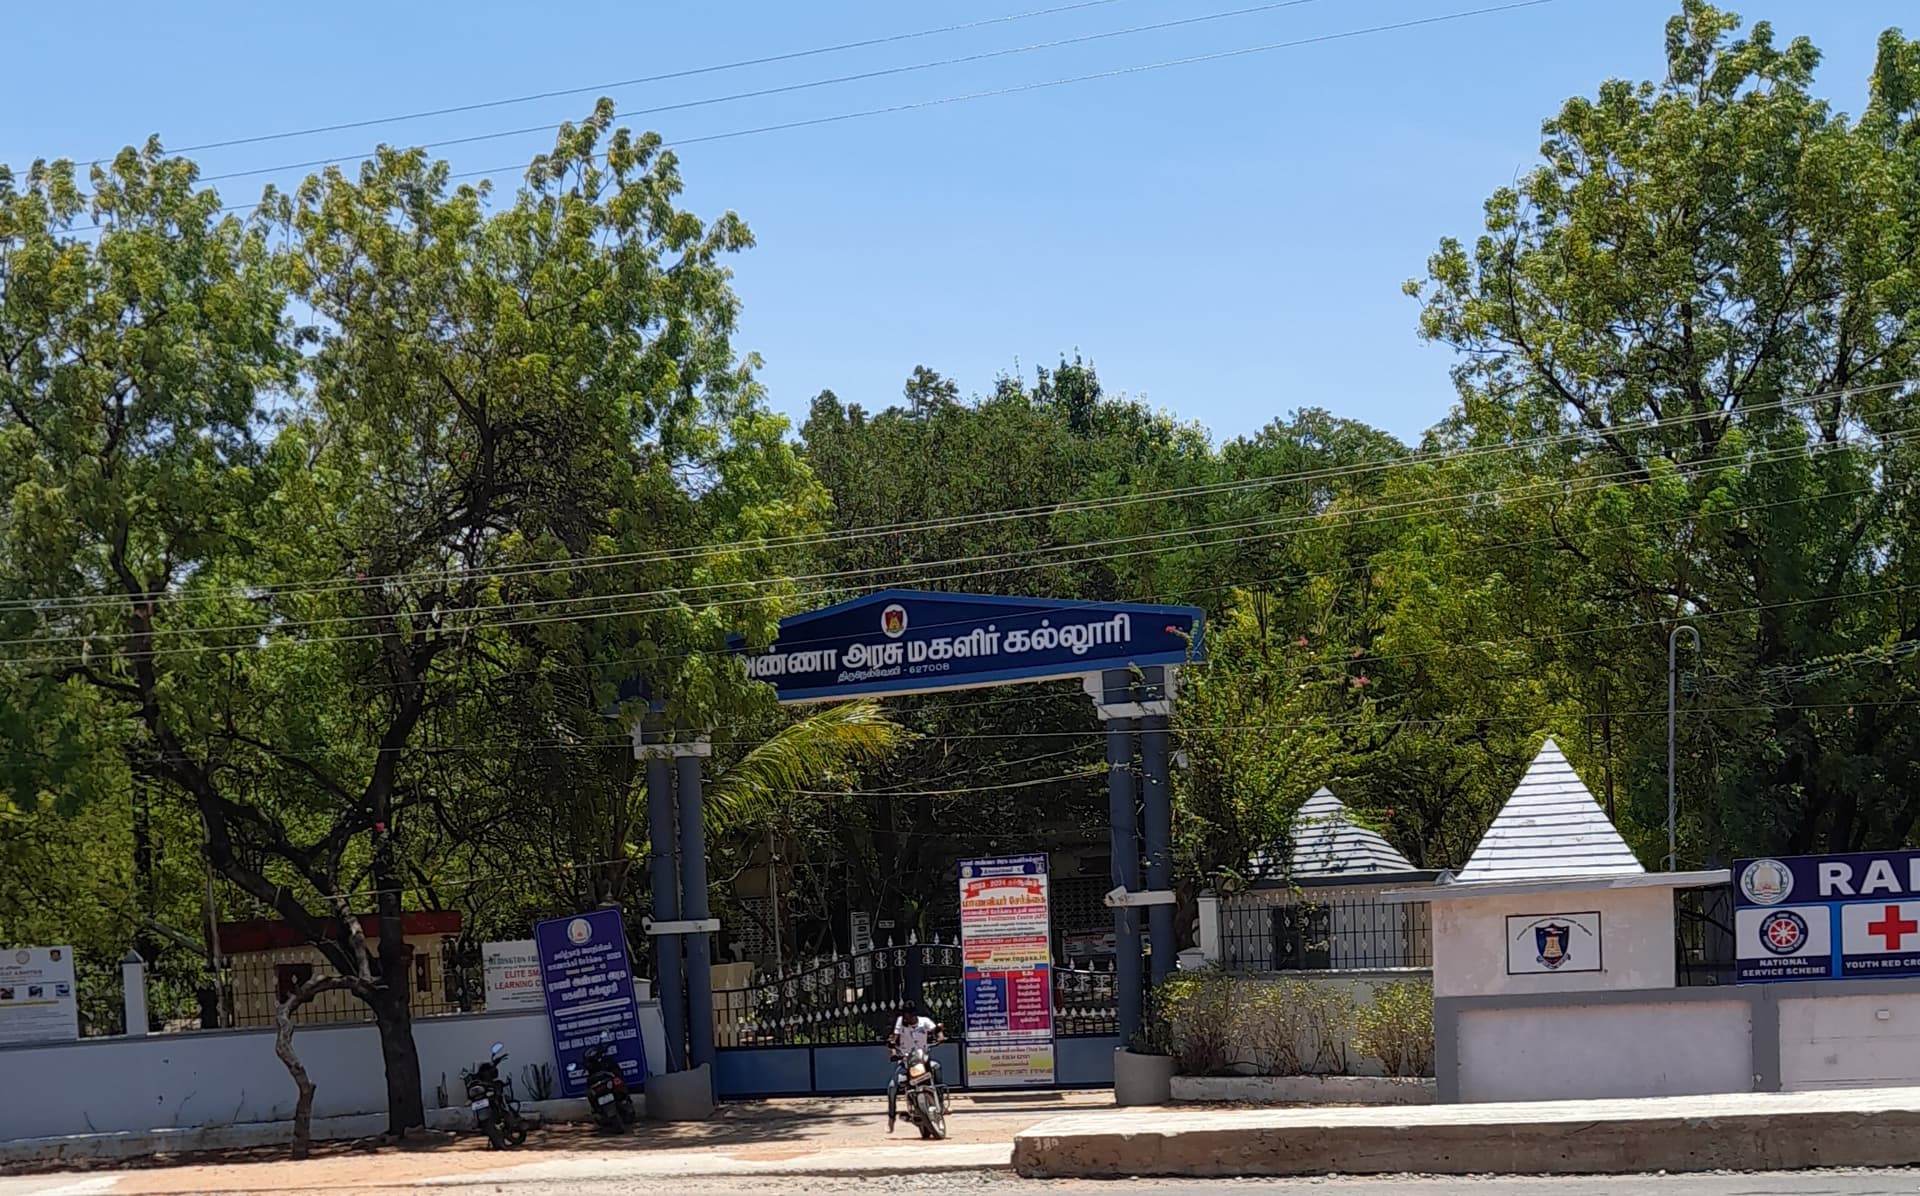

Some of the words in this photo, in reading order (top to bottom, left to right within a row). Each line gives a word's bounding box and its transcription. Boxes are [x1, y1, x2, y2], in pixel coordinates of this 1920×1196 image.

[842, 640, 904, 670] அரசு
[908, 624, 1001, 663] மகளிர்
[1003, 613, 1132, 655] கல்லூரி
[909, 662, 950, 674] 627008
[1759, 957, 1808, 967] NATIONAL
[1845, 960, 1880, 969] YOUTH
[1881, 959, 1902, 968] RED
[1742, 967, 1784, 977] SERVICE
[1785, 966, 1826, 975] SCHEME
